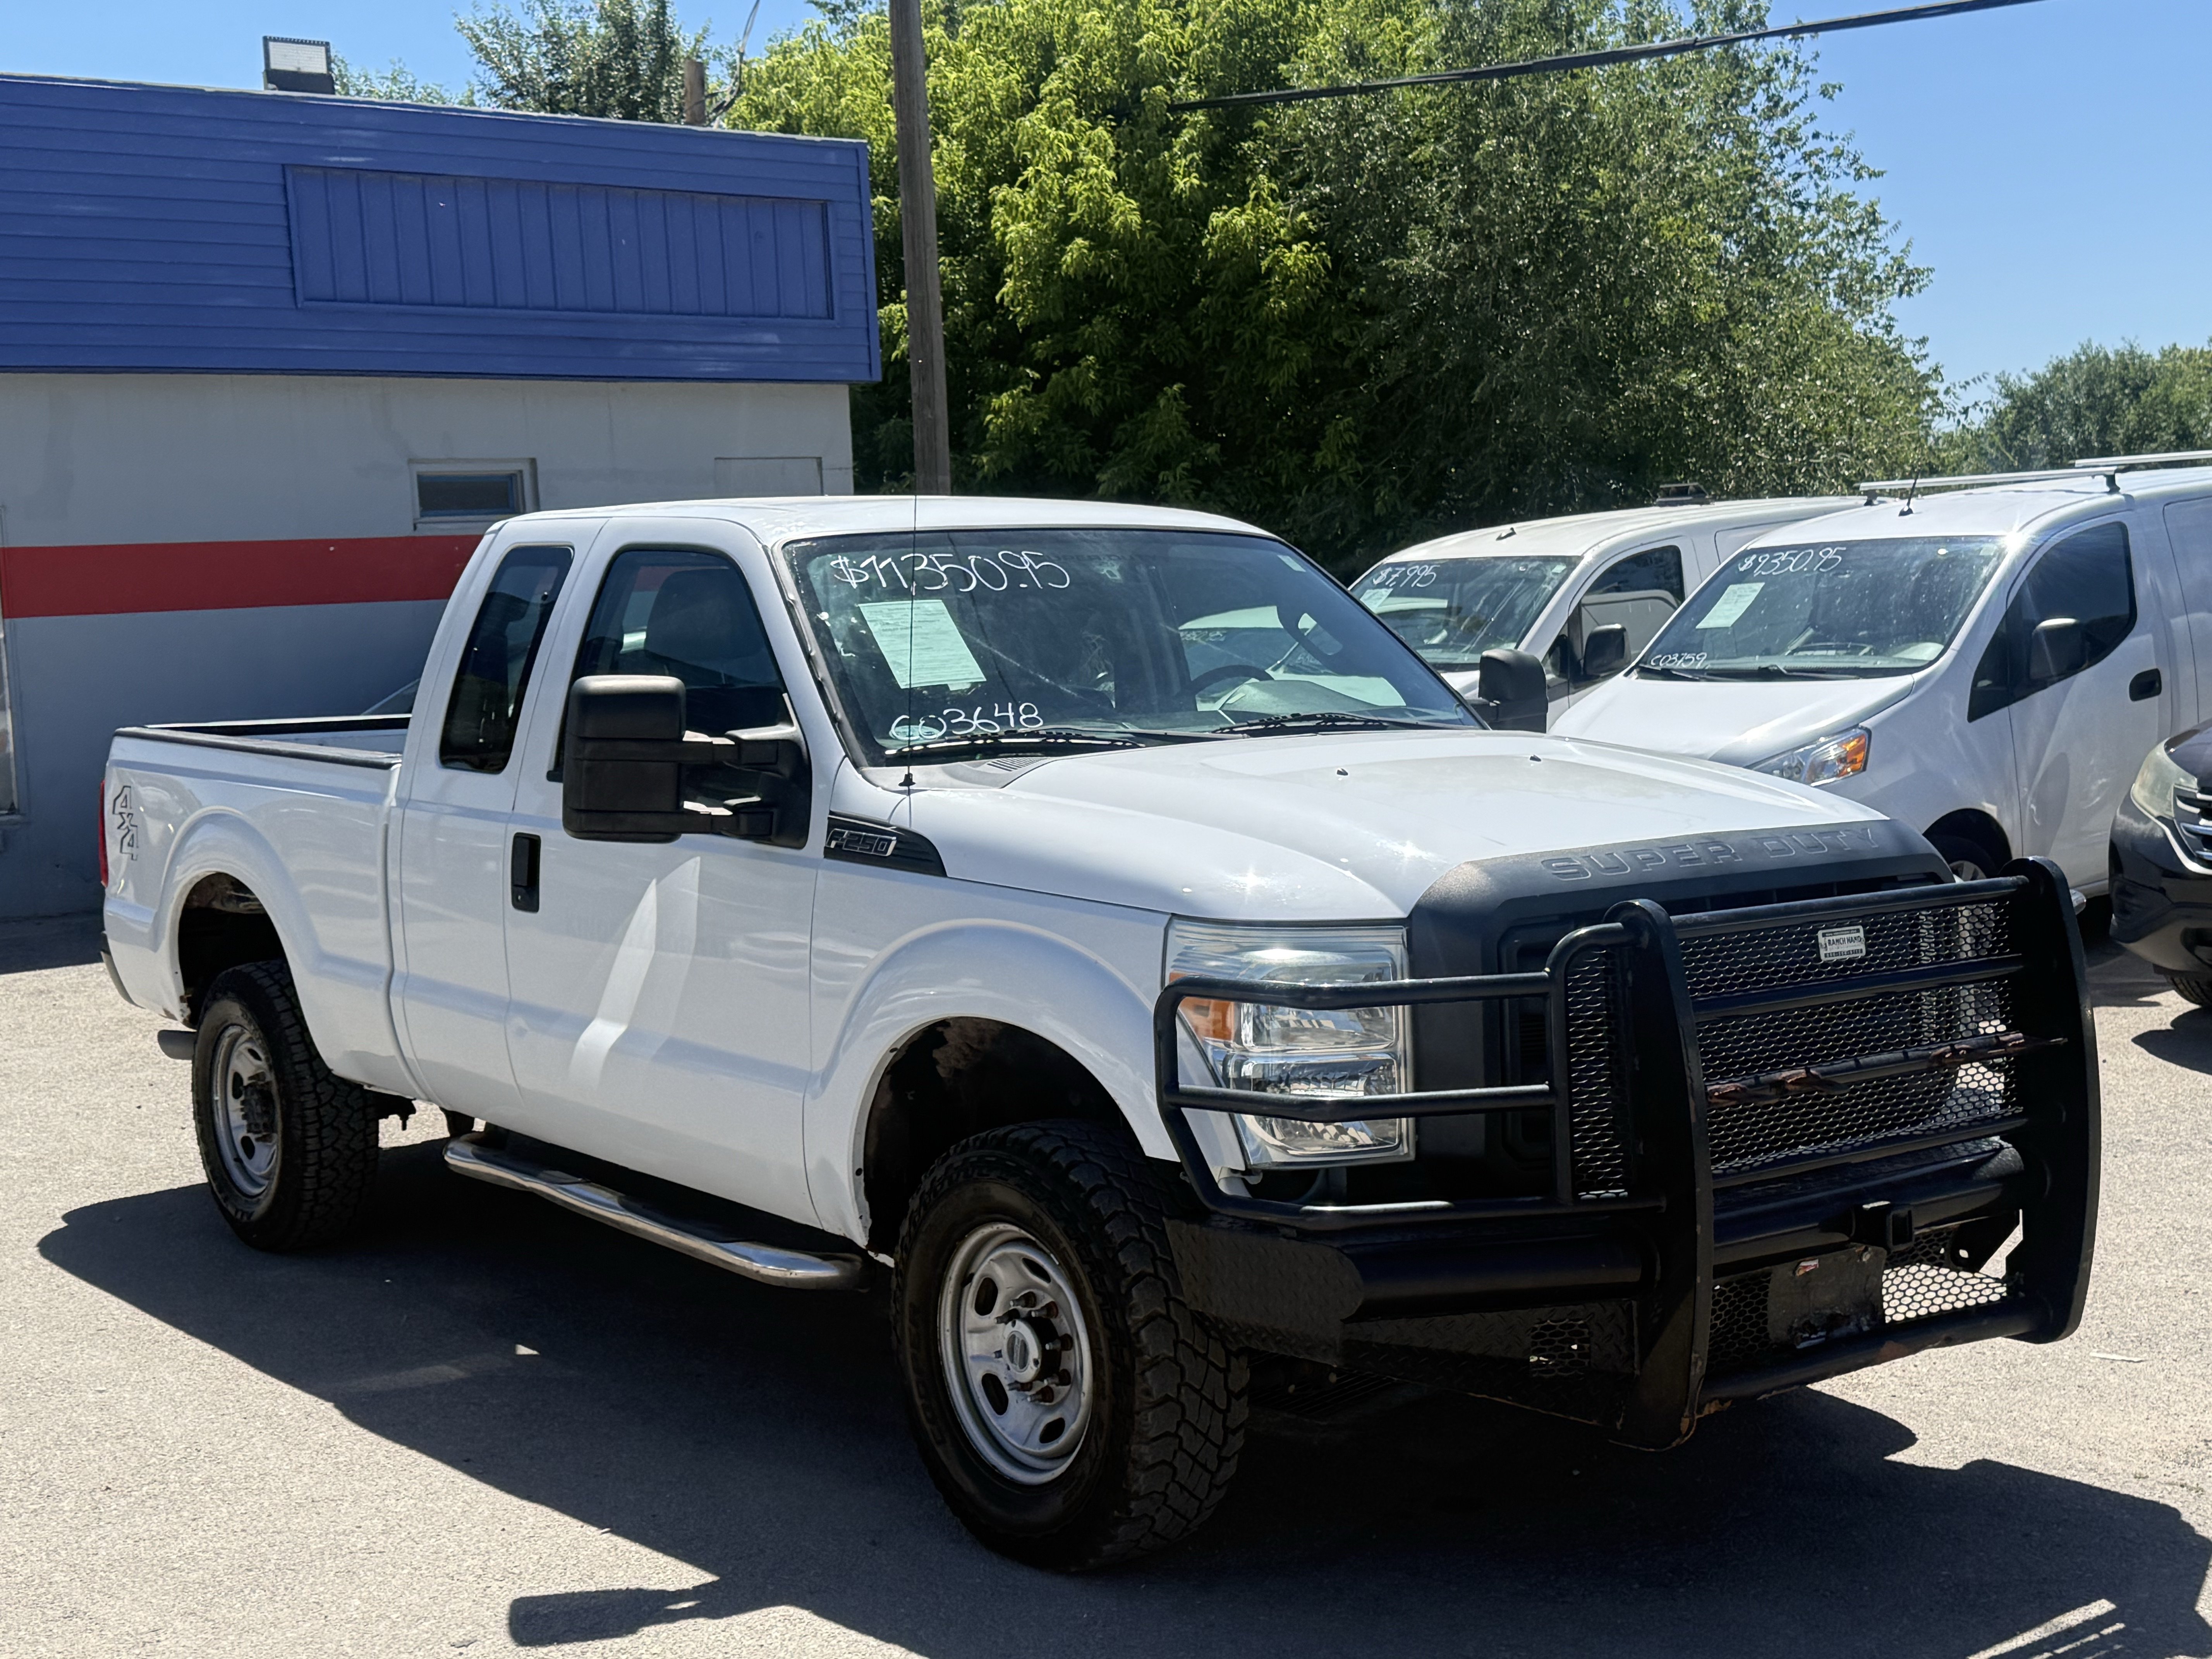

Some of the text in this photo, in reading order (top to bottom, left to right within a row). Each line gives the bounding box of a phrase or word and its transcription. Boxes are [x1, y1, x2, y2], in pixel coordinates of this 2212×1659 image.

[890, 702, 1043, 740] C03648
[1541, 828, 1881, 881] SUPER DUTY
[1828, 937, 1846, 946] RANCH
